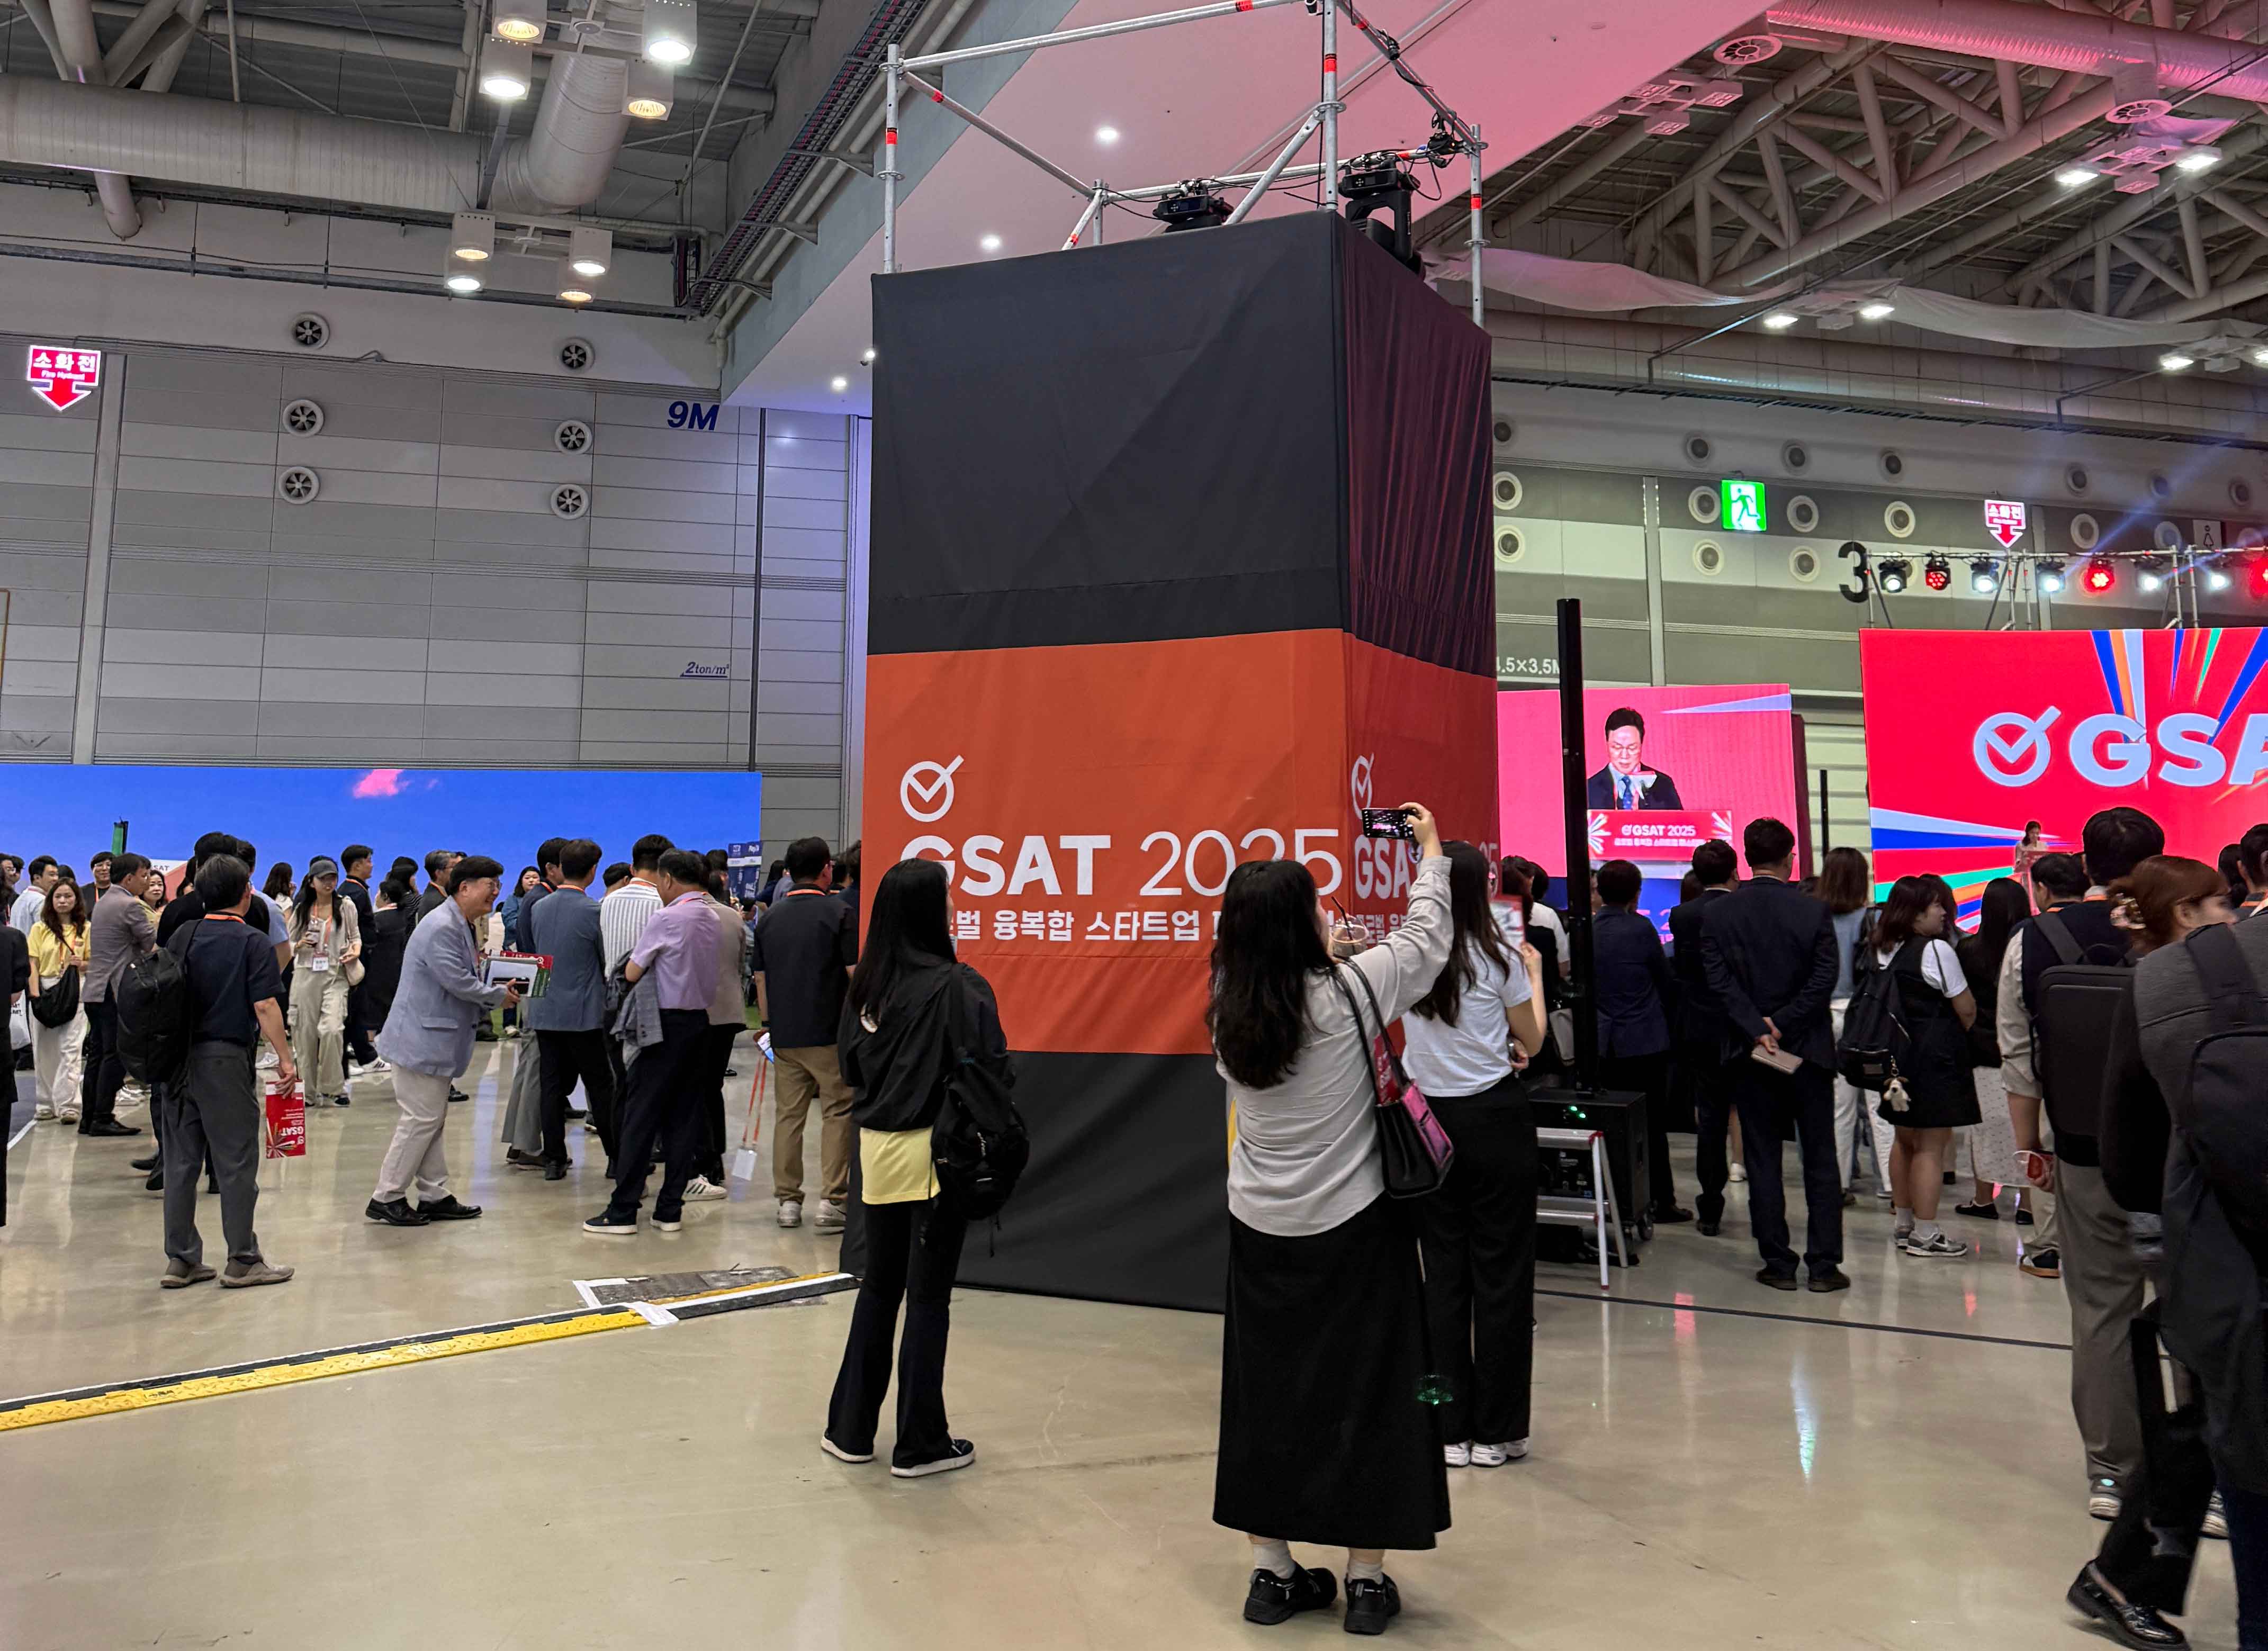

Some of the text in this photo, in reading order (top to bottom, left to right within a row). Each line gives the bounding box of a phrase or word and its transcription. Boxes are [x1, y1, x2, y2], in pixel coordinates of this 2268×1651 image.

[33, 352, 95, 372] 소화전
[667, 401, 720, 430] 9M
[1838, 542, 1869, 603] 3
[1668, 825, 1696, 836] 2025
[1355, 835, 1423, 899] GSA
[994, 910, 1075, 941] 융복합
[1085, 910, 1199, 941] 스타트업
[281, 1126, 304, 1136] GSAT
